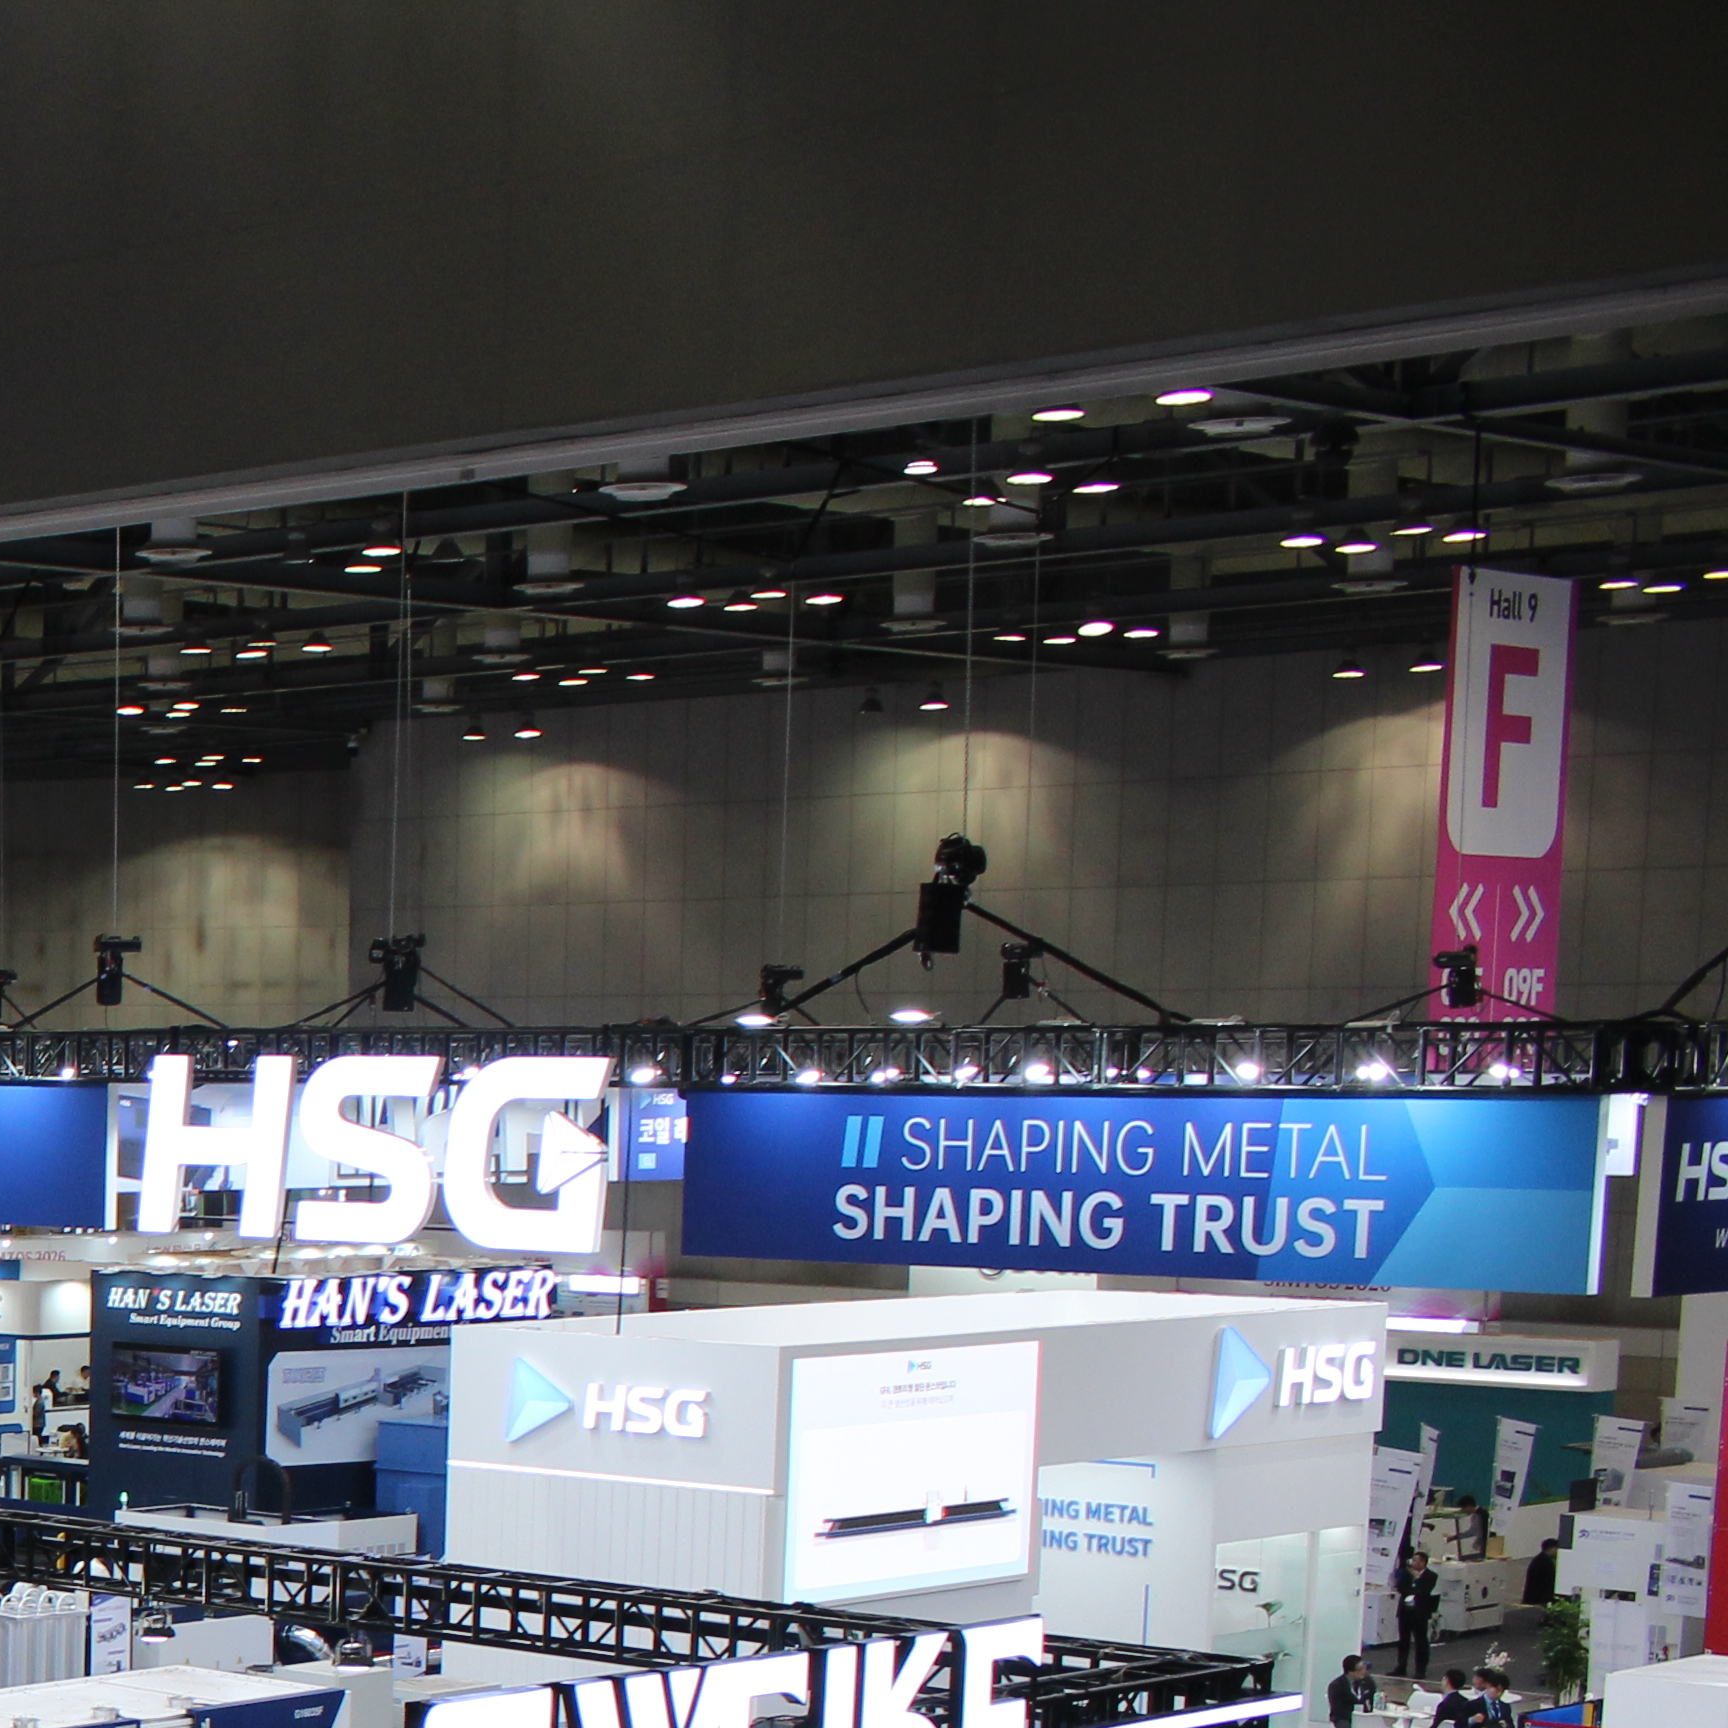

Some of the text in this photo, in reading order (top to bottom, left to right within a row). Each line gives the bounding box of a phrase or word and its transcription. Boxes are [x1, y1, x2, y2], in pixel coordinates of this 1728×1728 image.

[1488, 588, 1540, 623] Hall 9
[1481, 643, 1540, 809] F
[1503, 968, 1547, 1001] 09F
[652, 1093, 675, 1106] HSG
[638, 1117, 671, 1145] 코일
[138, 1054, 616, 1254] HSG
[901, 1117, 1390, 1182] SHAPING METAL
[832, 1183, 1386, 1262] SHAPING TRUST
[173, 1289, 242, 1315] LASER
[279, 1268, 557, 1330] HAN'S LASER
[129, 1312, 242, 1331] Smart Equipment Group
[330, 1322, 452, 1344] Smart Equipmen
[1274, 1340, 1378, 1408] HSG
[1396, 1347, 1582, 1376] DNE LASER
[581, 1382, 712, 1438] HSG
[1084, 1501, 1154, 1527] METAL
[1084, 1532, 1154, 1559] TRUST
[1216, 1568, 1259, 1594] SG
